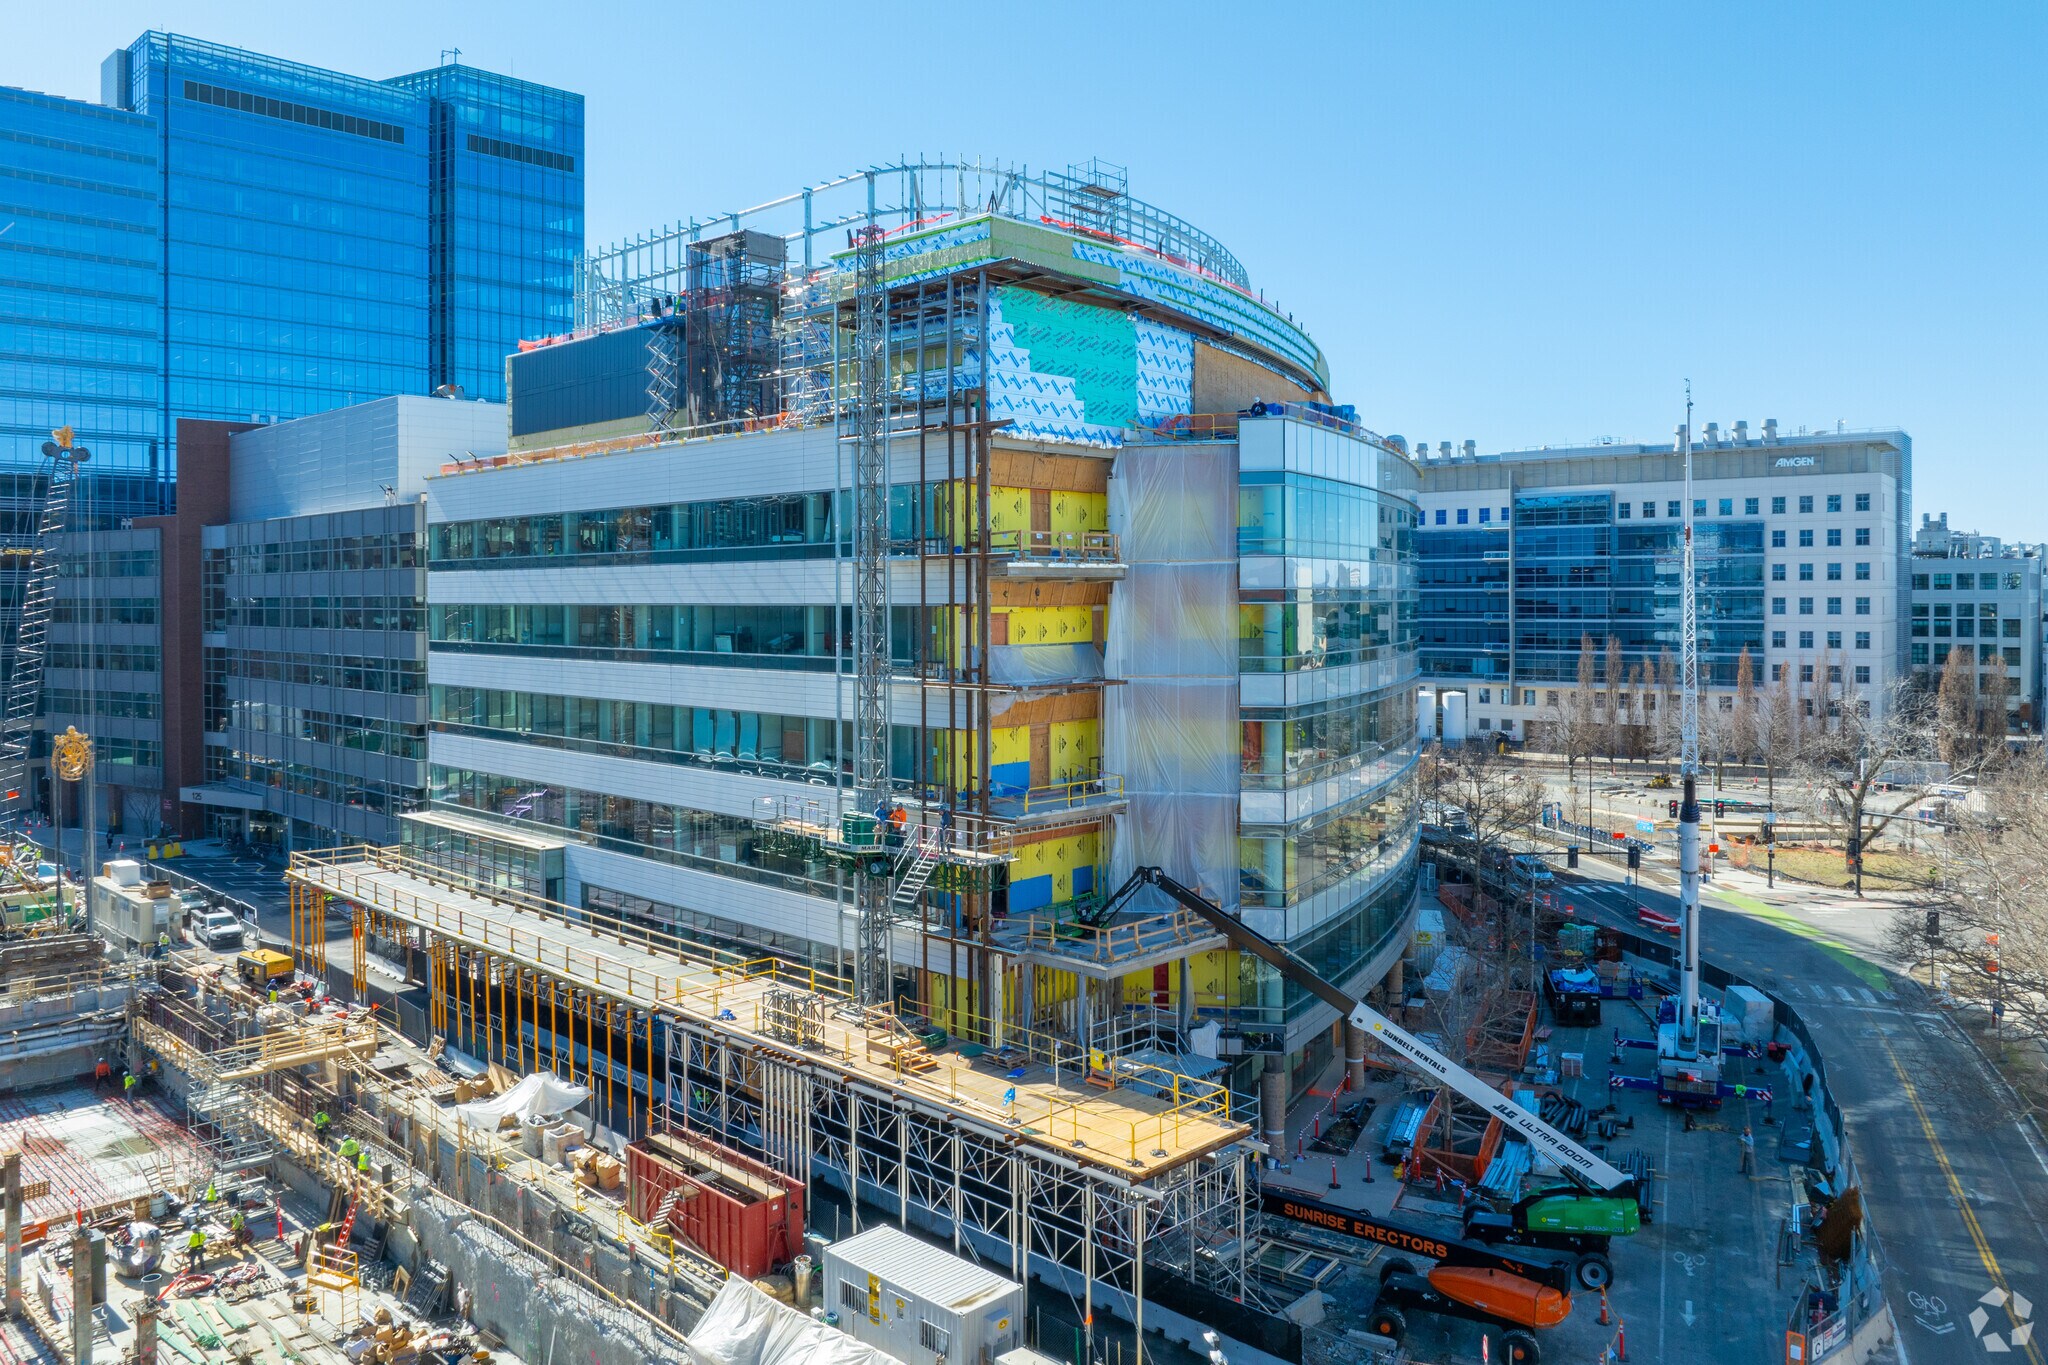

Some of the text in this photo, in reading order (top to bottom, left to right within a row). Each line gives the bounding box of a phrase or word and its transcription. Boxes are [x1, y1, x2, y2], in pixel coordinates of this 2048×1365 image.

[1775, 457, 1815, 467] AMGEN
[1383, 1029, 1447, 1074] SUNBELT RENTALS
[1492, 1104, 1594, 1168] JLG ULTRA BOOM
[1284, 1203, 1448, 1258] SUNRISE ERECTORS
